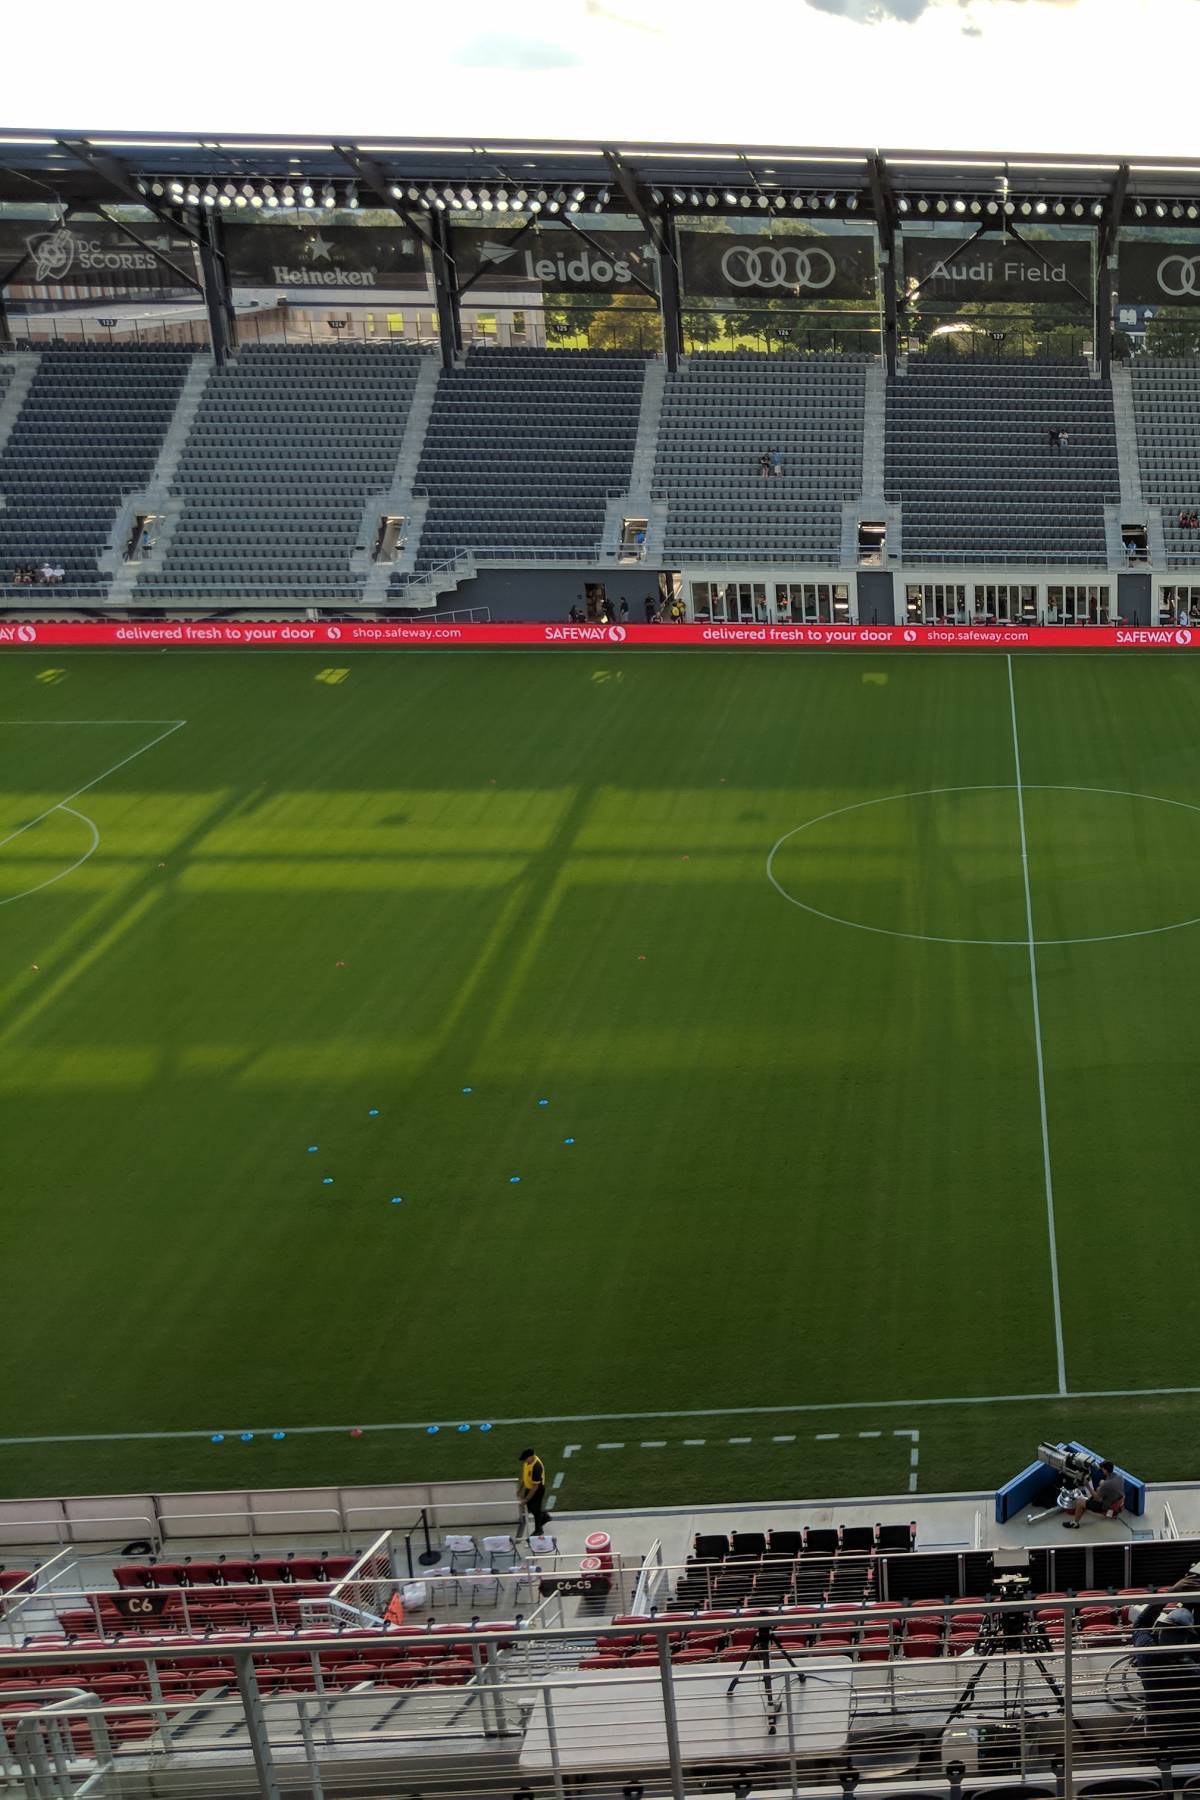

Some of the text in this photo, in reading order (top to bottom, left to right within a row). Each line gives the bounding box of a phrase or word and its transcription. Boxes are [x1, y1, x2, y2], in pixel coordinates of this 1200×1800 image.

[77, 241, 101, 253] DC
[79, 254, 157, 269] SCORES
[525, 250, 632, 283] leidos
[273, 266, 376, 287] Heineken
[931, 261, 1067, 282] Audi Field
[117, 627, 315, 641] delivered fresh to your door
[353, 628, 461, 640] shop.safeway.com
[545, 628, 607, 640] SAFEWAY
[704, 628, 892, 642] delivered fresh to your door
[928, 630, 1029, 642] shop.safeway.com
[1117, 631, 1173, 643] SAFEWAY
[556, 1581, 592, 1590] C6-C5
[128, 1598, 153, 1613] C6
